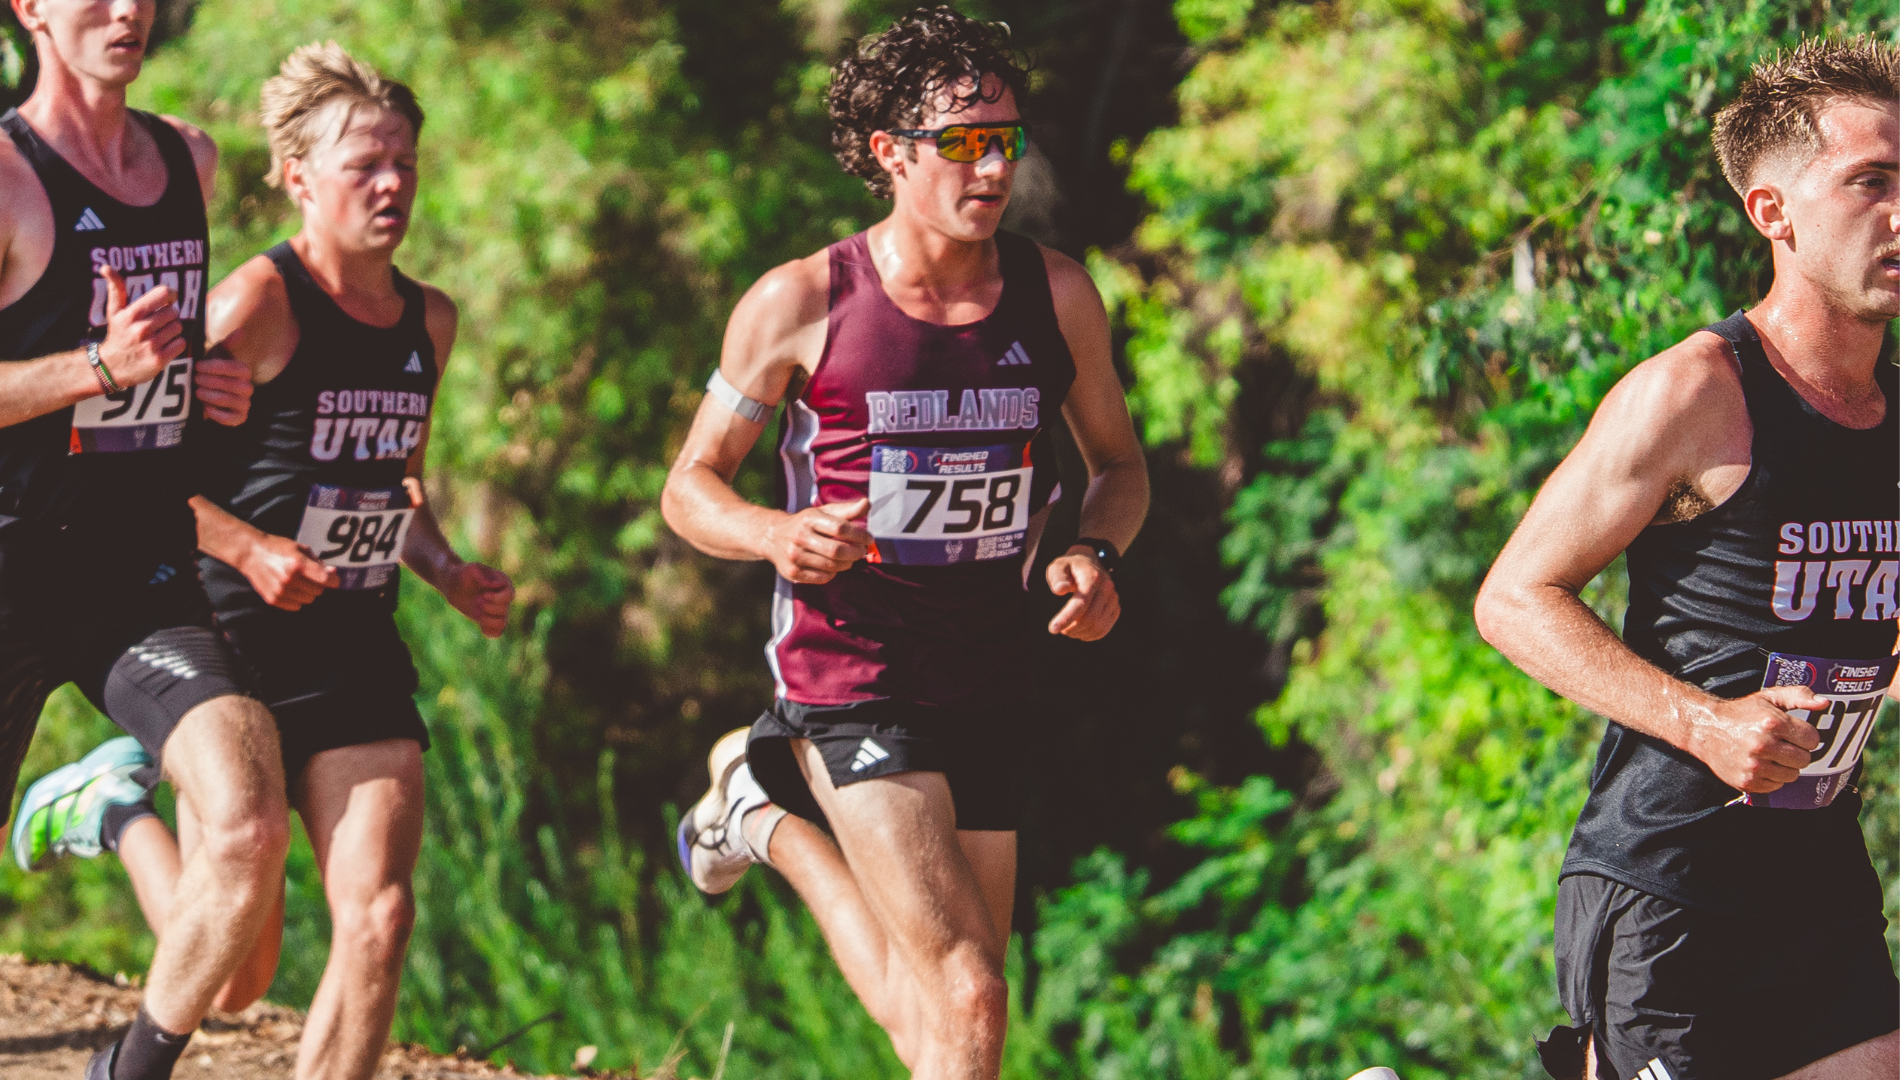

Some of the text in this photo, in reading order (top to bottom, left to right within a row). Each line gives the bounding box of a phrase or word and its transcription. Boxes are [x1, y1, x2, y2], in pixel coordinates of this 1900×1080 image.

[90, 239, 204, 274] SOUTHERN
[317, 390, 428, 415] SOUTHERN
[866, 387, 1040, 434] REDLANDS
[310, 418, 424, 461] UTAH
[942, 451, 989, 462] FINISHED
[938, 463, 986, 474] RESULTS
[901, 474, 1022, 534] 758
[319, 513, 405, 562] 984
[1771, 559, 1899, 621] UTA
[1834, 680, 1874, 692] RESULTS
[1840, 666, 1880, 678] FINISHED
